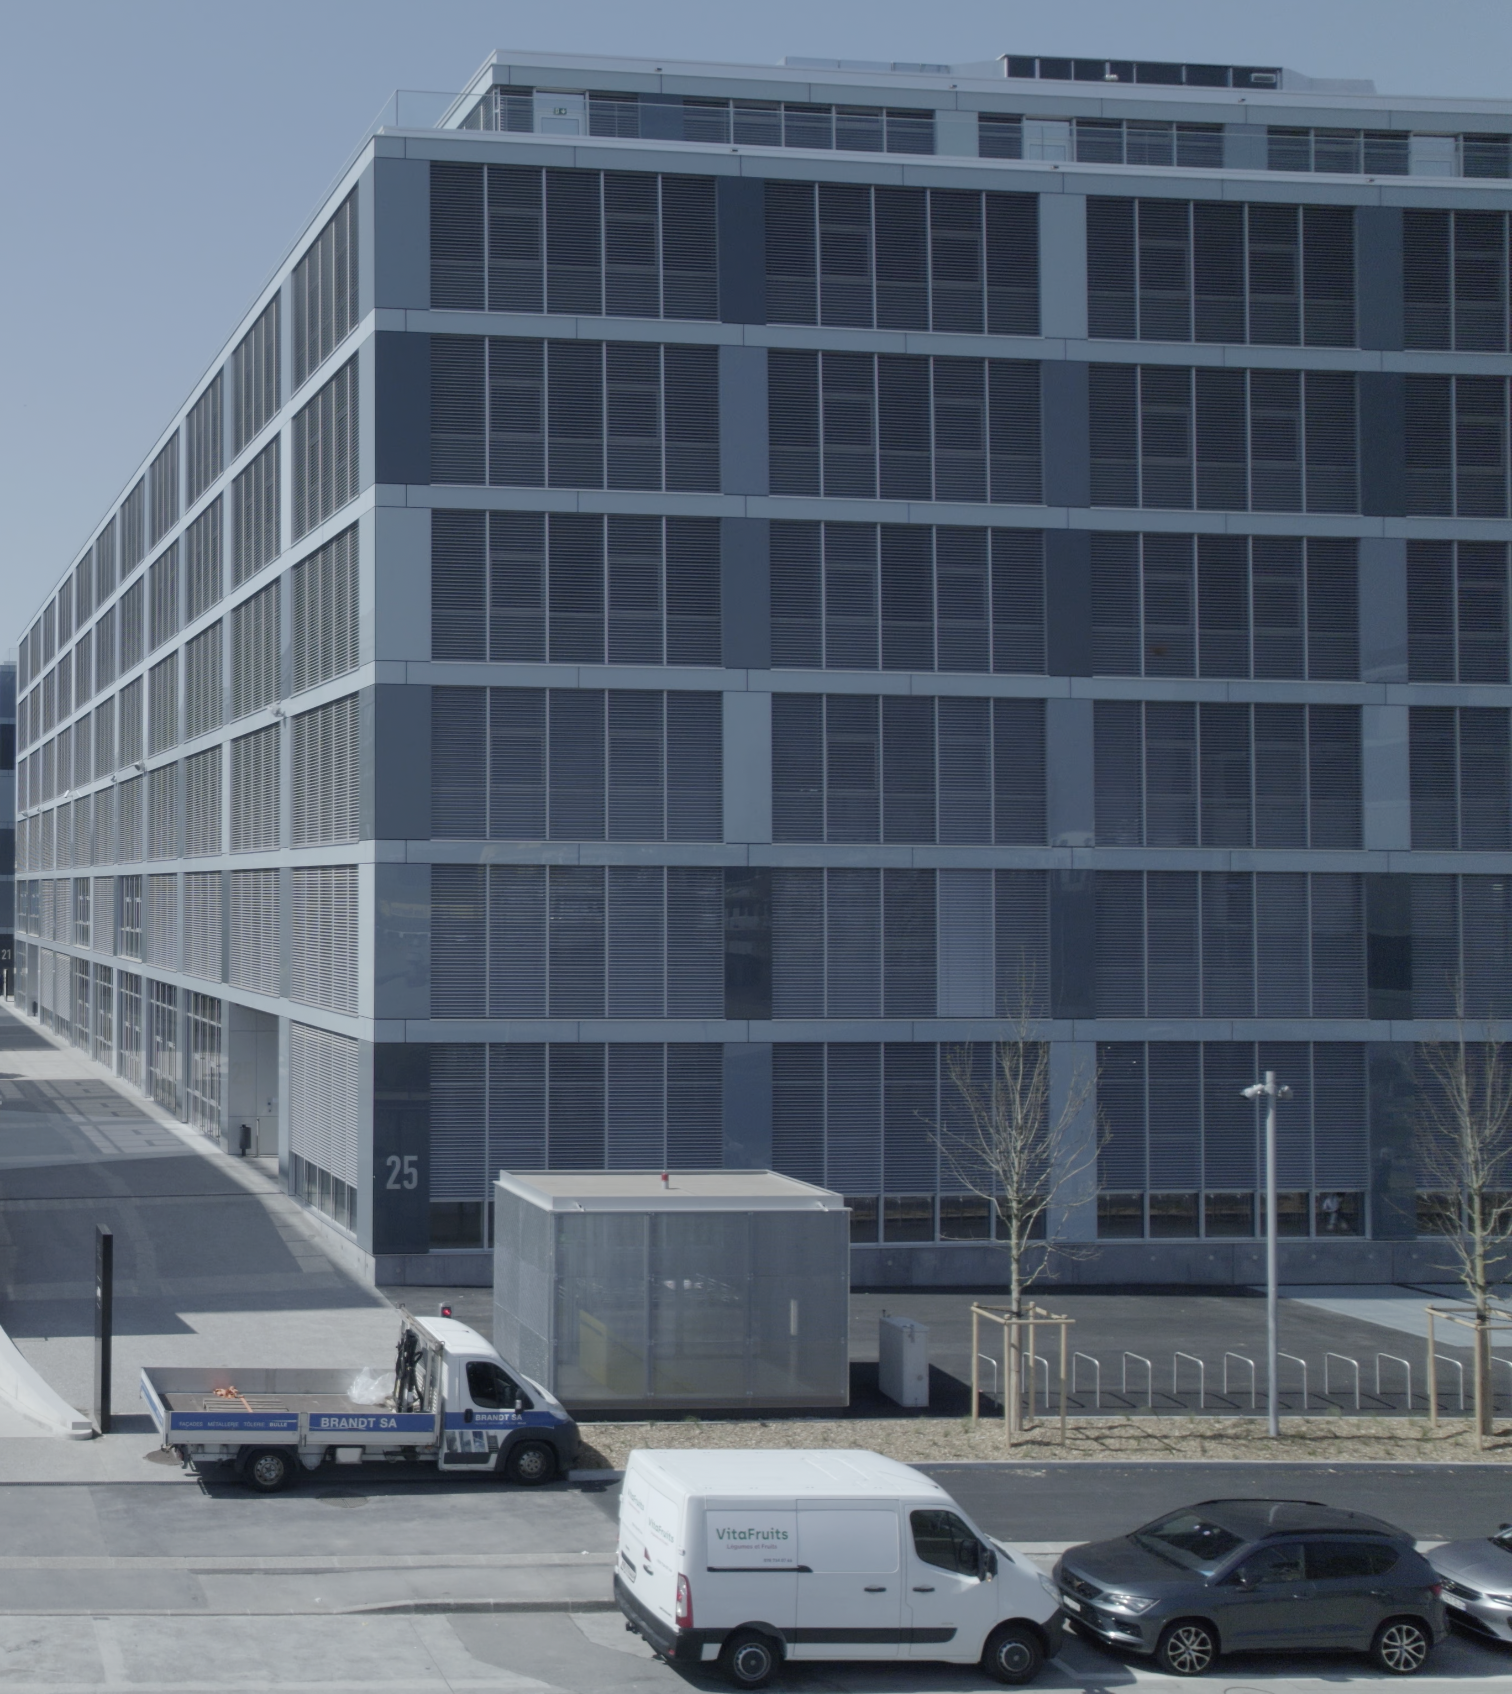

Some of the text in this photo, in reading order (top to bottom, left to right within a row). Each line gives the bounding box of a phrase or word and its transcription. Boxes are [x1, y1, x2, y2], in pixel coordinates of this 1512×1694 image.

[1, 949, 11, 960] 21
[386, 1154, 418, 1190] 25
[320, 1417, 398, 1429] BRANDT SA
[716, 1527, 789, 1540] VitaFruits
